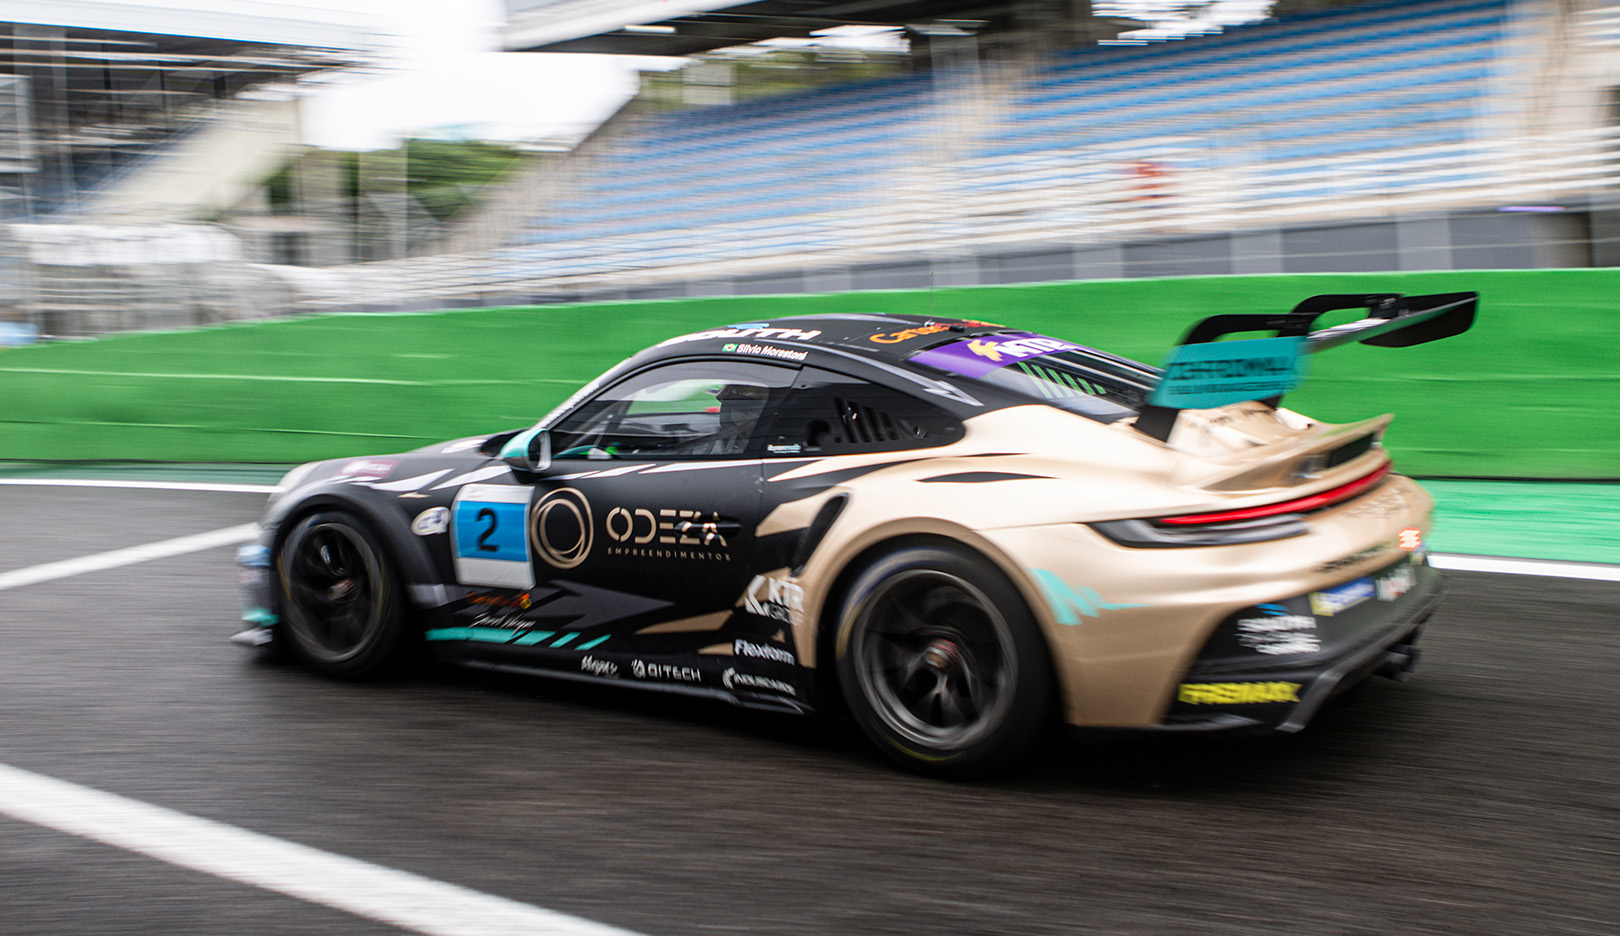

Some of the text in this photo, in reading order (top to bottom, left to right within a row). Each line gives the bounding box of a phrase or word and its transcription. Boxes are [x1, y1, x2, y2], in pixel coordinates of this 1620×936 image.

[737, 343, 762, 355] Silvio
[477, 508, 497, 552] 2
[607, 547, 731, 561] EMPREENDIMENTOS
